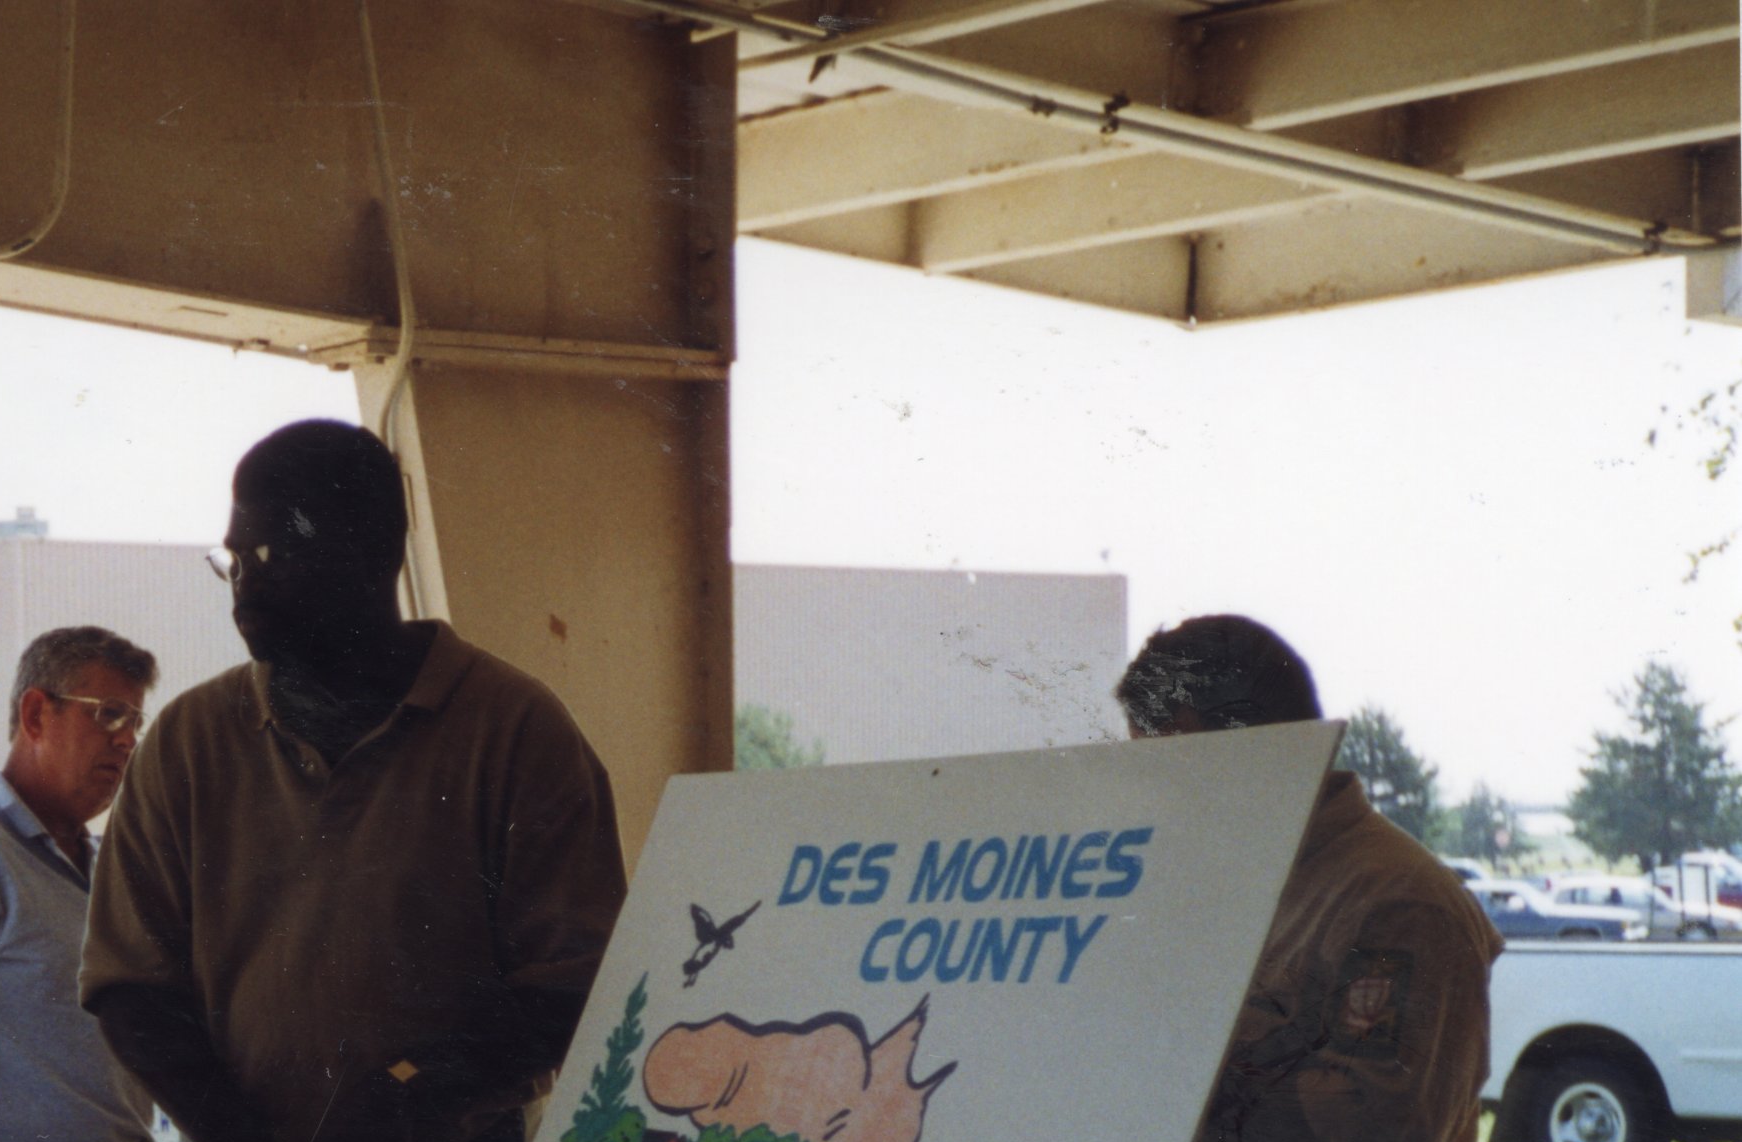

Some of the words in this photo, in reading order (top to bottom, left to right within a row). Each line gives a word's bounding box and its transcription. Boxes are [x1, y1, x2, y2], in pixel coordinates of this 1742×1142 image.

[777, 842, 898, 906] DES
[907, 827, 1155, 904] MOINES
[859, 914, 1109, 984] COUNTY
